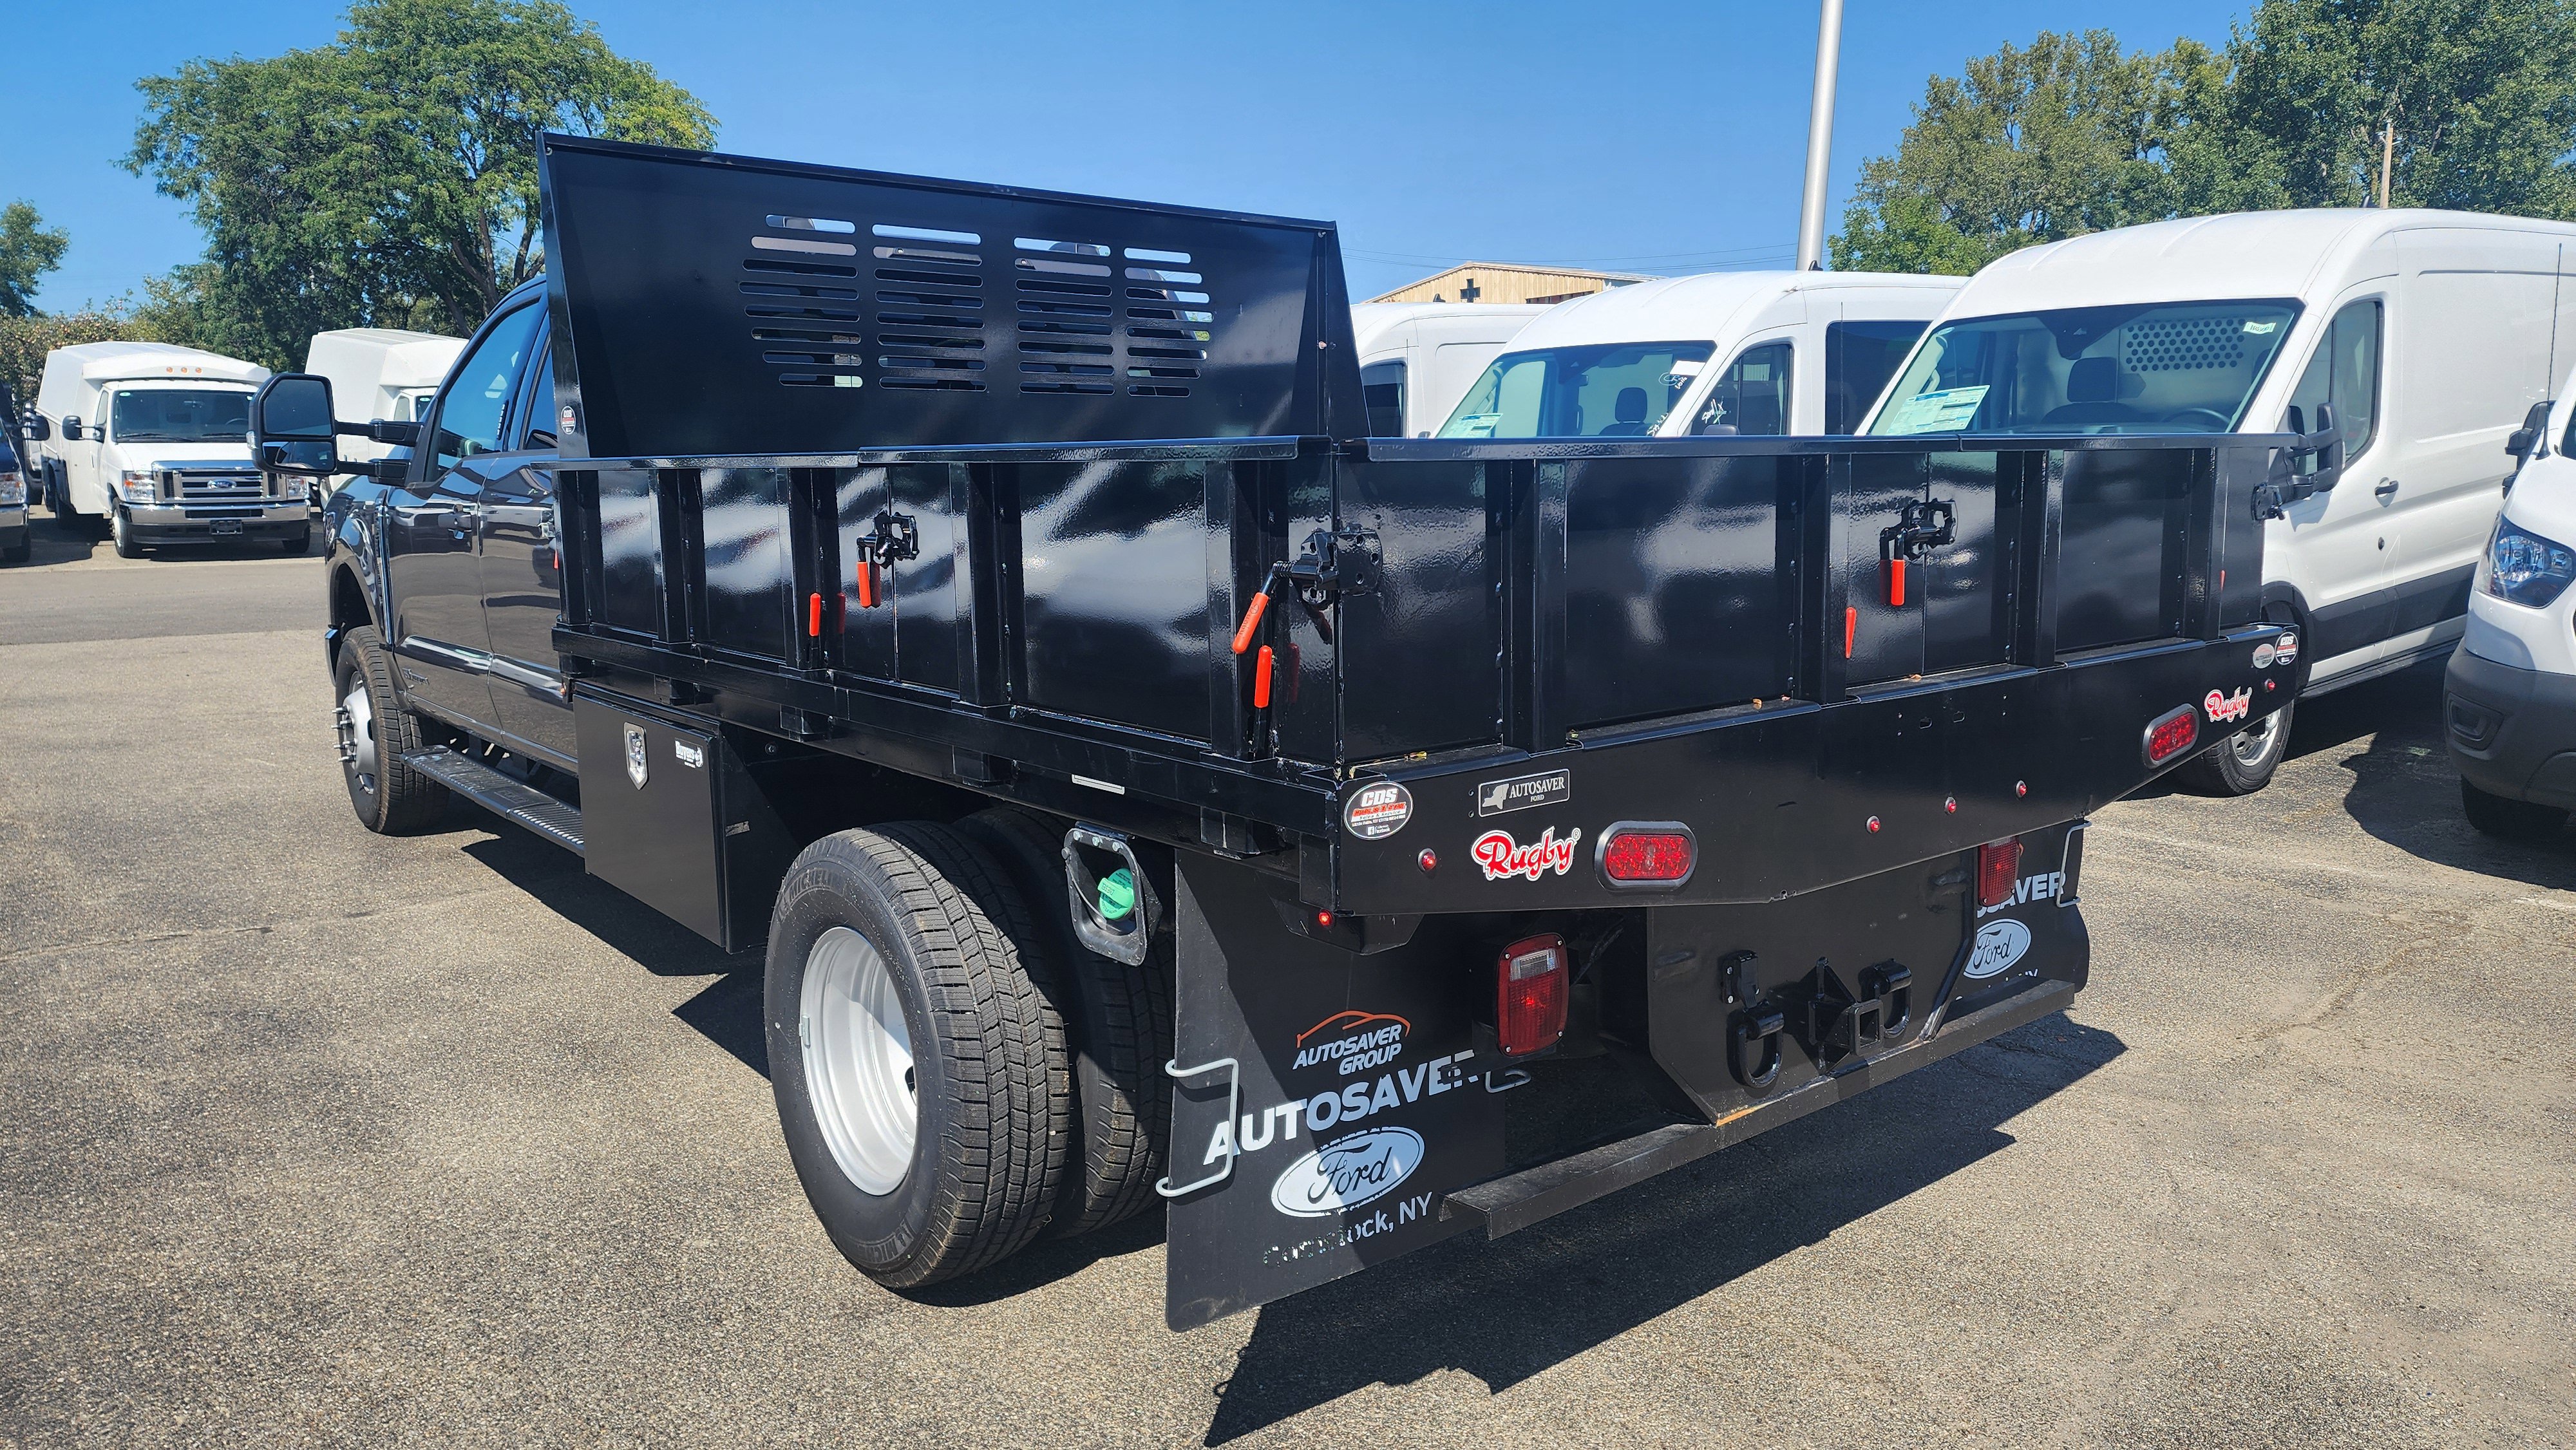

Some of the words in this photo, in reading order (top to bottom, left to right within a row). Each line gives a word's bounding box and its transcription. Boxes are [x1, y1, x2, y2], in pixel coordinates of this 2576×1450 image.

[2205, 687, 2250, 722] Rugby
[1361, 788, 1398, 807] CDS
[1508, 777, 1566, 799] AUTOSAVER
[1530, 793, 1545, 802] FORD
[1472, 827, 1577, 881] Rugby
[1973, 928, 2012, 970] Ford
[1293, 1024, 1402, 1070] AUTOSAVER
[1338, 1043, 1402, 1076] GROUP
[1307, 1142, 1395, 1204] Ford
[1399, 1192, 1433, 1225] NY
